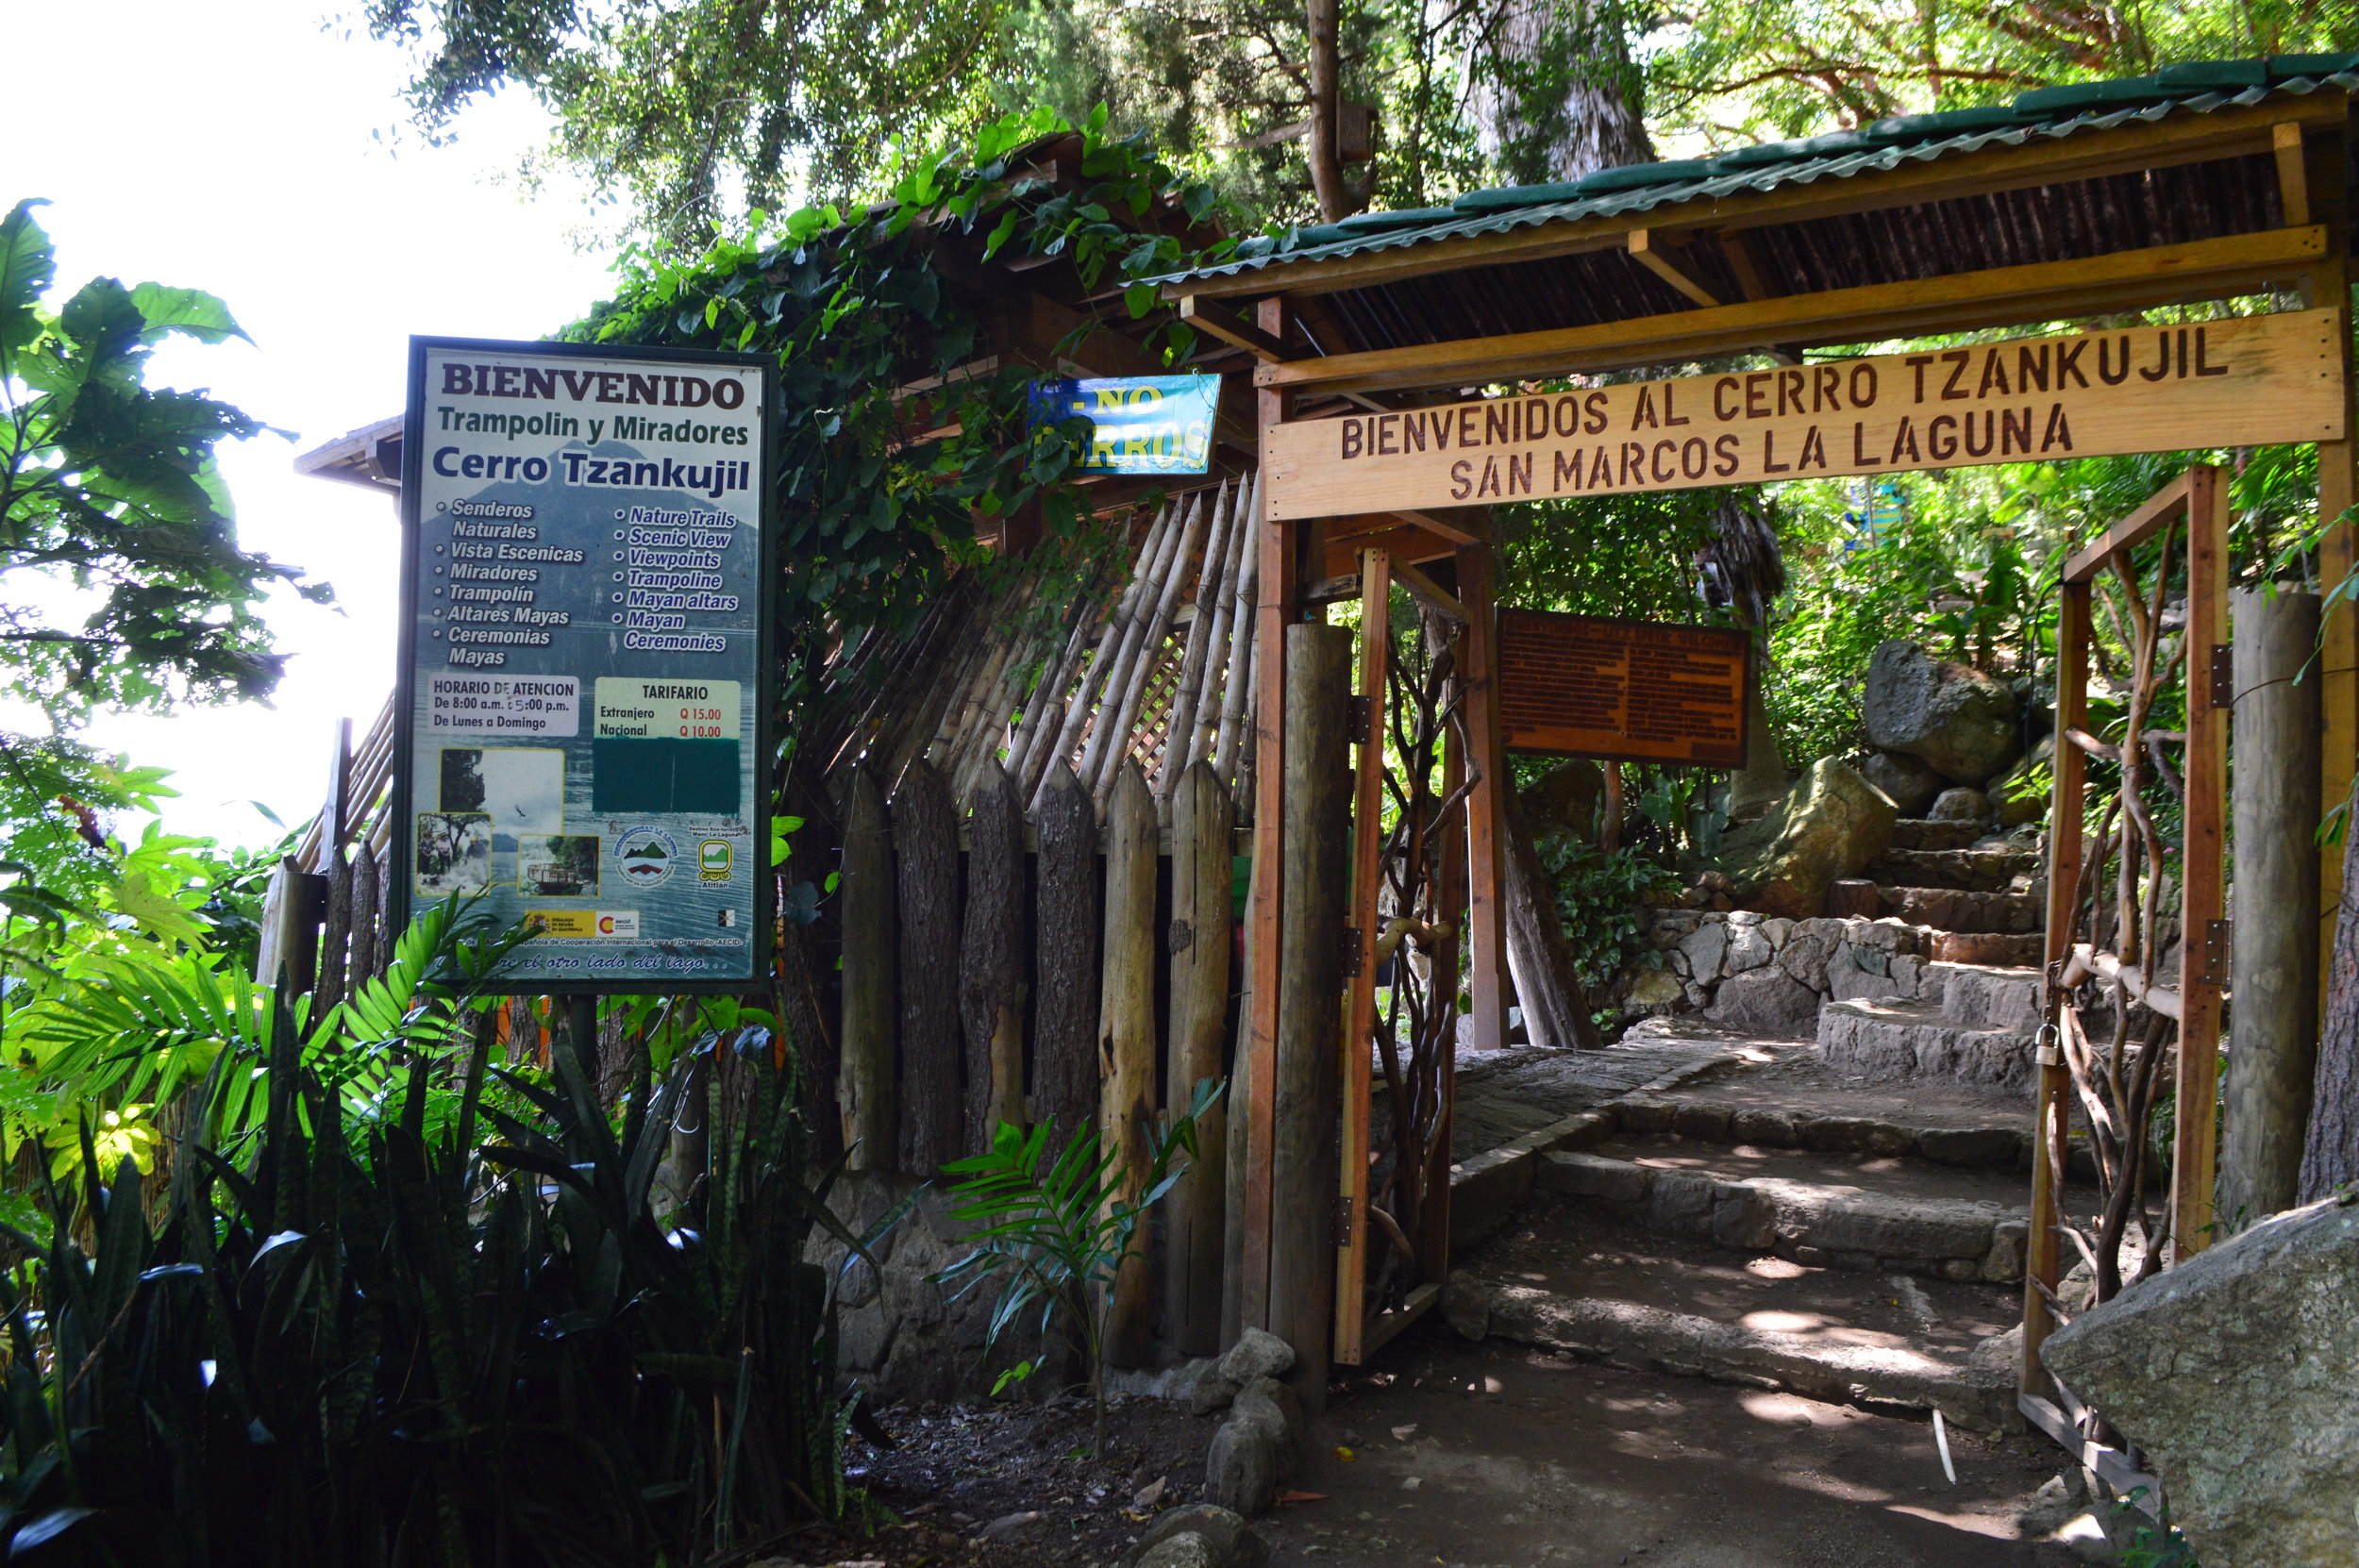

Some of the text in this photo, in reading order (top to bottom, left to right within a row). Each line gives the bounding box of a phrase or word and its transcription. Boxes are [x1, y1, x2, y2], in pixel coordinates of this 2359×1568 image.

[441, 363, 745, 410] BIENVENIDO
[1341, 326, 2229, 459] BIENVENIDOS AL CERRO TZANKUJIL
[437, 407, 748, 446] Trampolin y Miradores
[1449, 402, 2073, 500] SAN MARCOS LA LAGUNA
[432, 446, 750, 499] Cerro Tzankujil
[452, 499, 533, 519] Senderos
[630, 507, 736, 528] Nature Trails
[453, 521, 537, 541] Naturales
[628, 528, 730, 548] Scenic View
[450, 542, 583, 563] Vista Escenicas
[629, 549, 720, 569] Viewpoints
[449, 563, 537, 582] Miradores
[627, 570, 723, 591] Trampoline
[449, 584, 533, 605] Trampolín
[627, 592, 737, 611] Mayan altars
[446, 607, 569, 627] Altares Mayas
[627, 611, 684, 631] Mayan
[448, 626, 550, 646] Ceremonias
[625, 631, 725, 652] Ceremonies
[448, 648, 505, 666] Mayas
[434, 680, 574, 696] HORARIO DE ATENCION
[643, 685, 708, 700] TARIFARIO
[434, 697, 449, 709] De
[453, 697, 477, 709] 8:00
[480, 701, 504, 709] a.m.
[545, 701, 569, 713] p.m.
[600, 706, 721, 721] Extranjero Q 15.00
[434, 714, 546, 731] De Lunes a Domingo
[600, 724, 721, 738] Nacional Q 10.00
[560, 938, 606, 947] Cooperación
[524, 954, 541, 968] el
[546, 955, 579, 968] otro
[587, 954, 626, 969] lado
[633, 954, 661, 969] del
